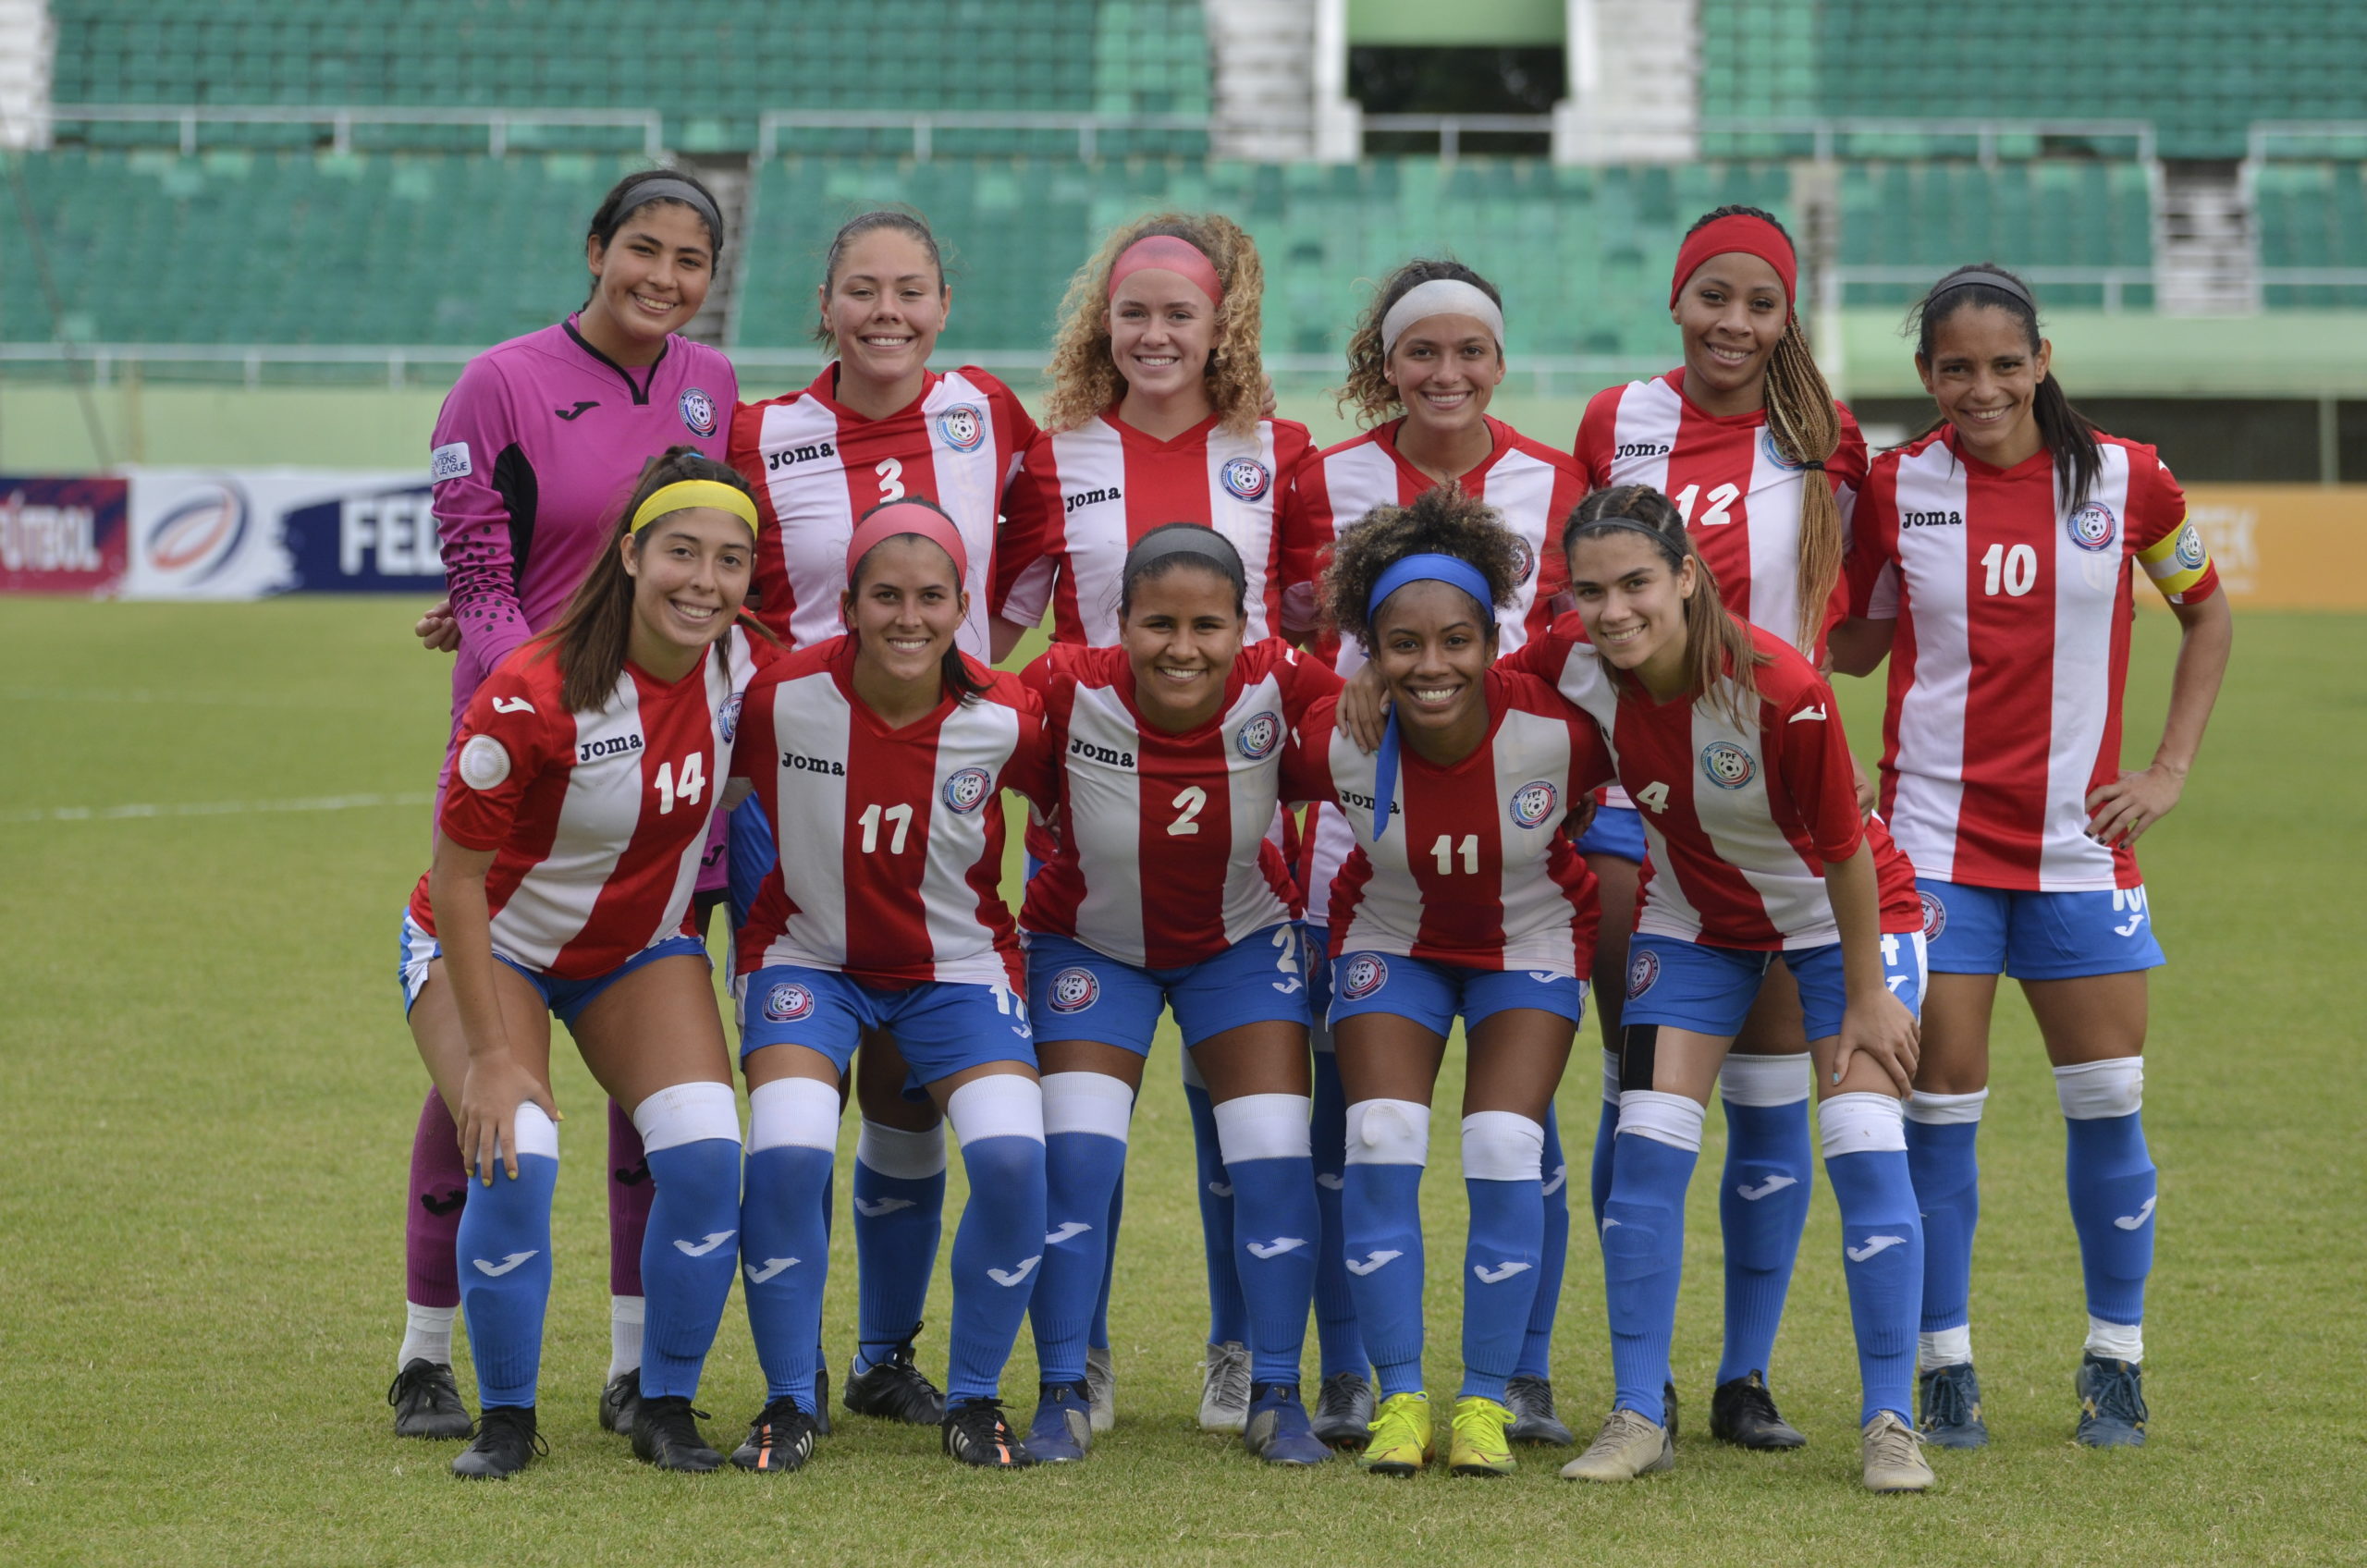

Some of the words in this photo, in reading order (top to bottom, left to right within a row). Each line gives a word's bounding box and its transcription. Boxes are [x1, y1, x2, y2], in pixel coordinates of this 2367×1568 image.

[876, 458, 905, 503] 3
[1674, 483, 1740, 529] 12
[1981, 543, 2037, 597] 10
[1720, 751, 1737, 760] FPF
[654, 751, 706, 815] 14
[963, 777, 978, 785] FPF
[1637, 780, 1670, 815] 4
[858, 802, 914, 855] 17
[1166, 786, 1207, 836] 2
[1429, 834, 1478, 875] 11
[1271, 924, 1298, 974] 2
